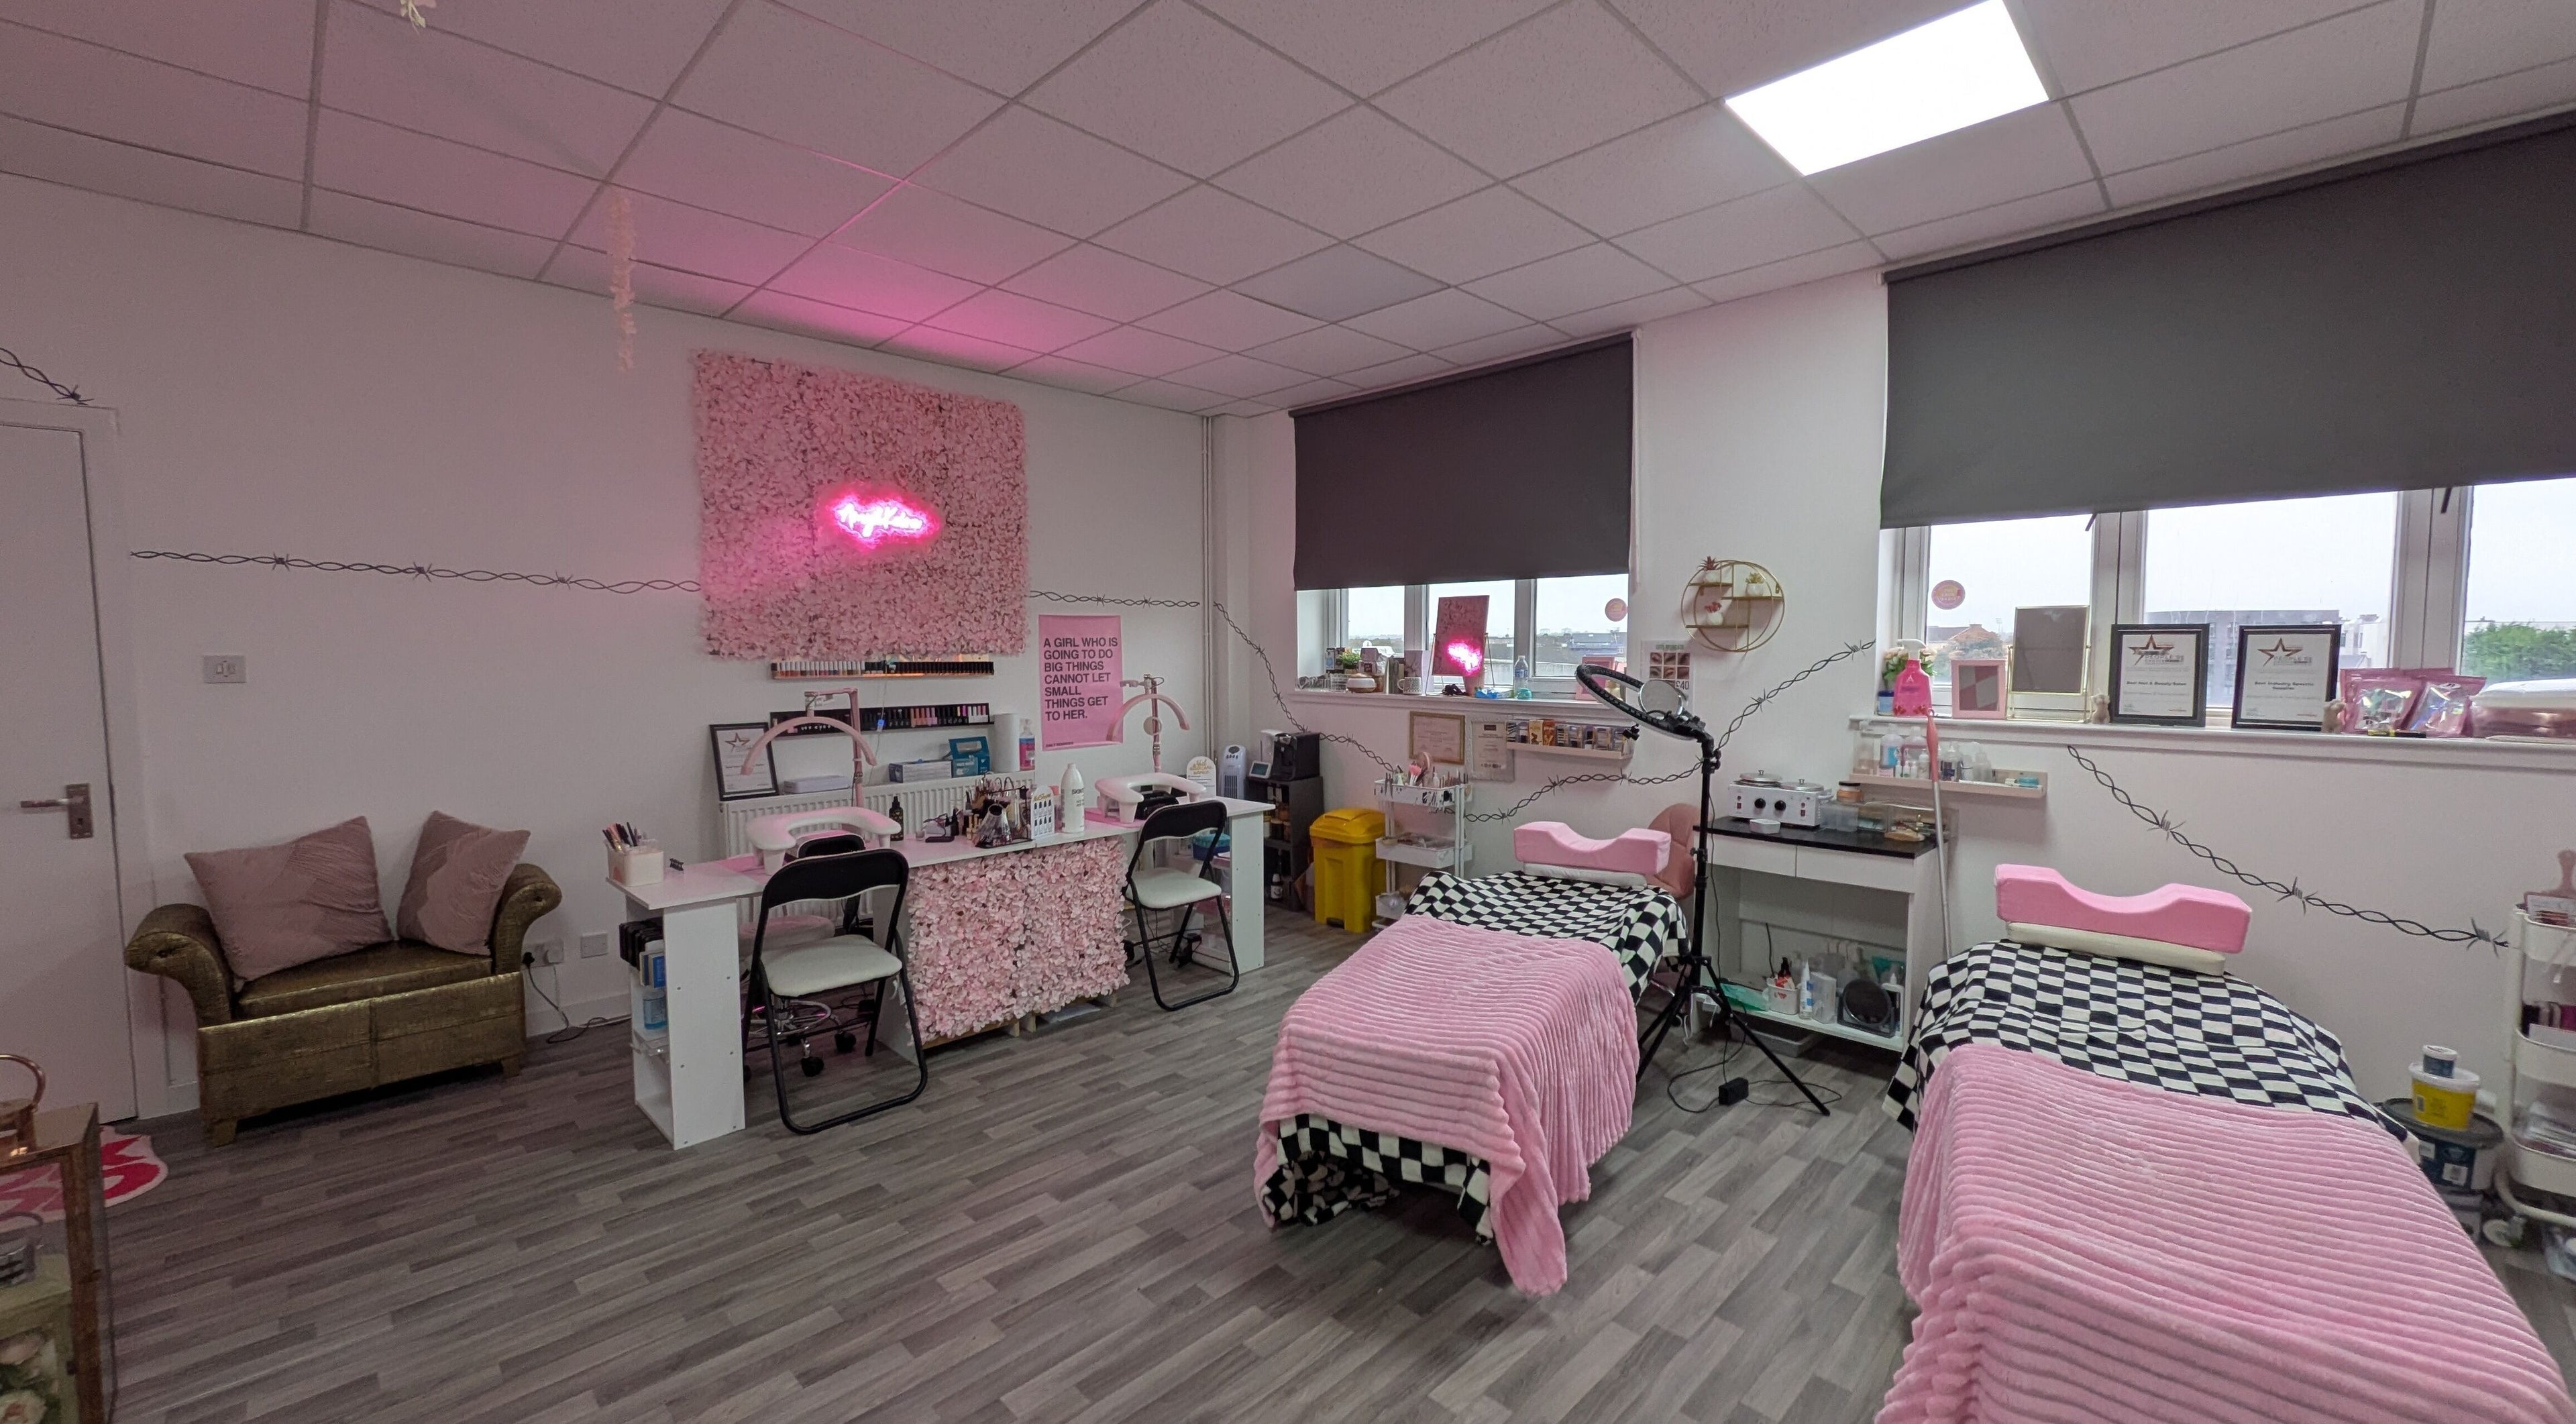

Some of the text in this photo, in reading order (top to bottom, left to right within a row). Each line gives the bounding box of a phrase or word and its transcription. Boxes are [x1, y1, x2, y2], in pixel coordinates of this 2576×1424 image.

[1044, 637, 1118, 647] A GIRL WHO IS
[1044, 649, 1113, 660] GOING TO DO
[1044, 661, 1104, 672] BIG THINGS
[1044, 673, 1111, 684] CANNOT LET
[1676, 680, 1689, 690] £40
[1044, 686, 1081, 696] SMALL
[1045, 696, 1108, 709] THINGS GET
[1045, 709, 1087, 721] TO HER.
